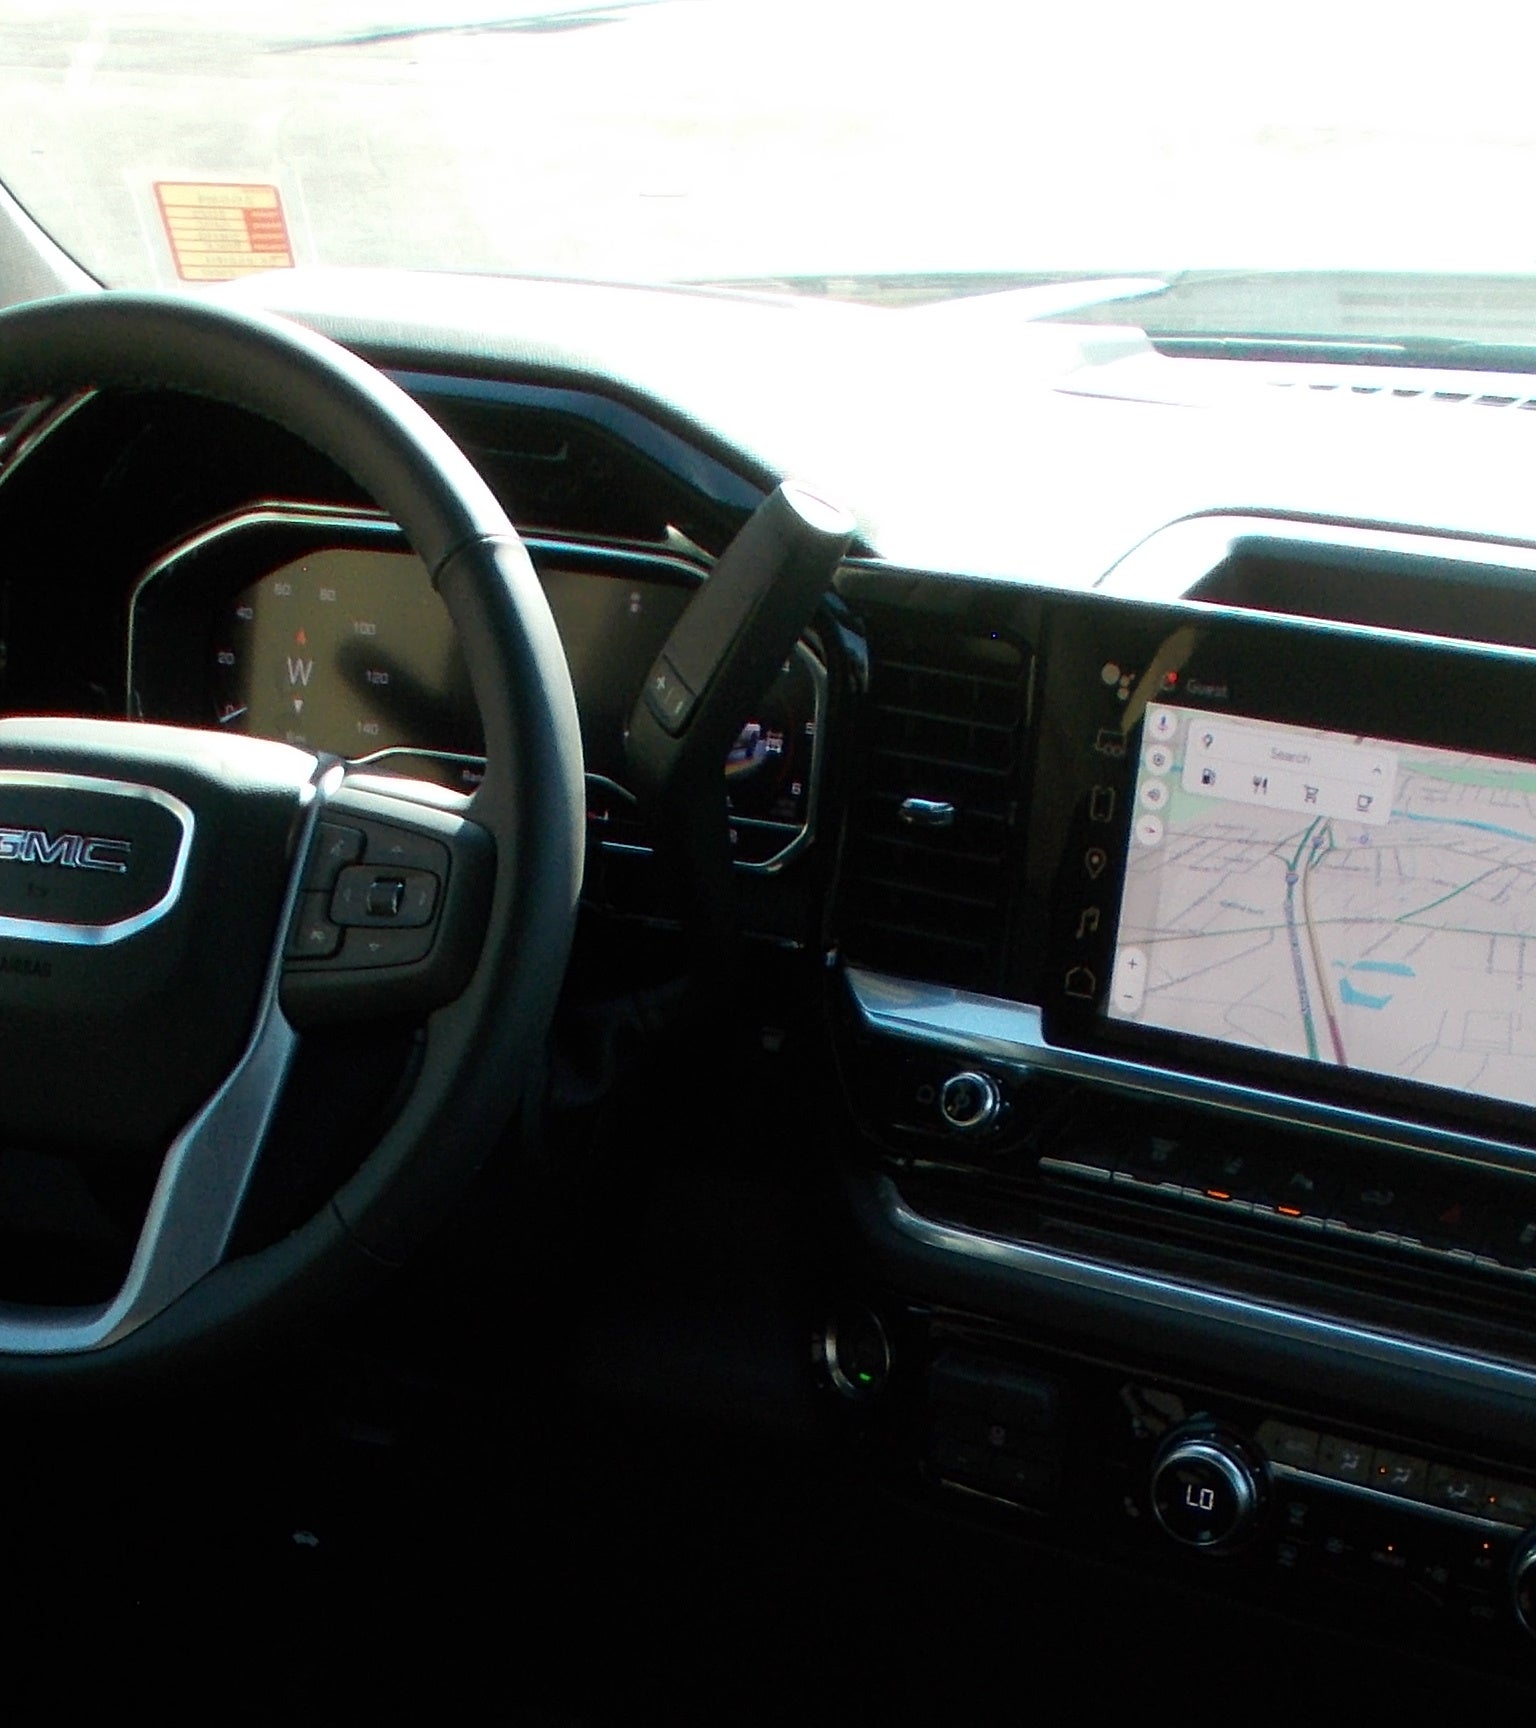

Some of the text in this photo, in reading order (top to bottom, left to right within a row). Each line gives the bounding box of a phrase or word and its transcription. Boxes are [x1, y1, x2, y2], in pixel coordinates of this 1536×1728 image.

[354, 622, 376, 636] 100
[217, 651, 235, 665] 20
[287, 656, 313, 686] W
[366, 669, 389, 685] 120
[1270, 747, 1312, 765] Search
[1186, 1484, 1215, 1511] LO
